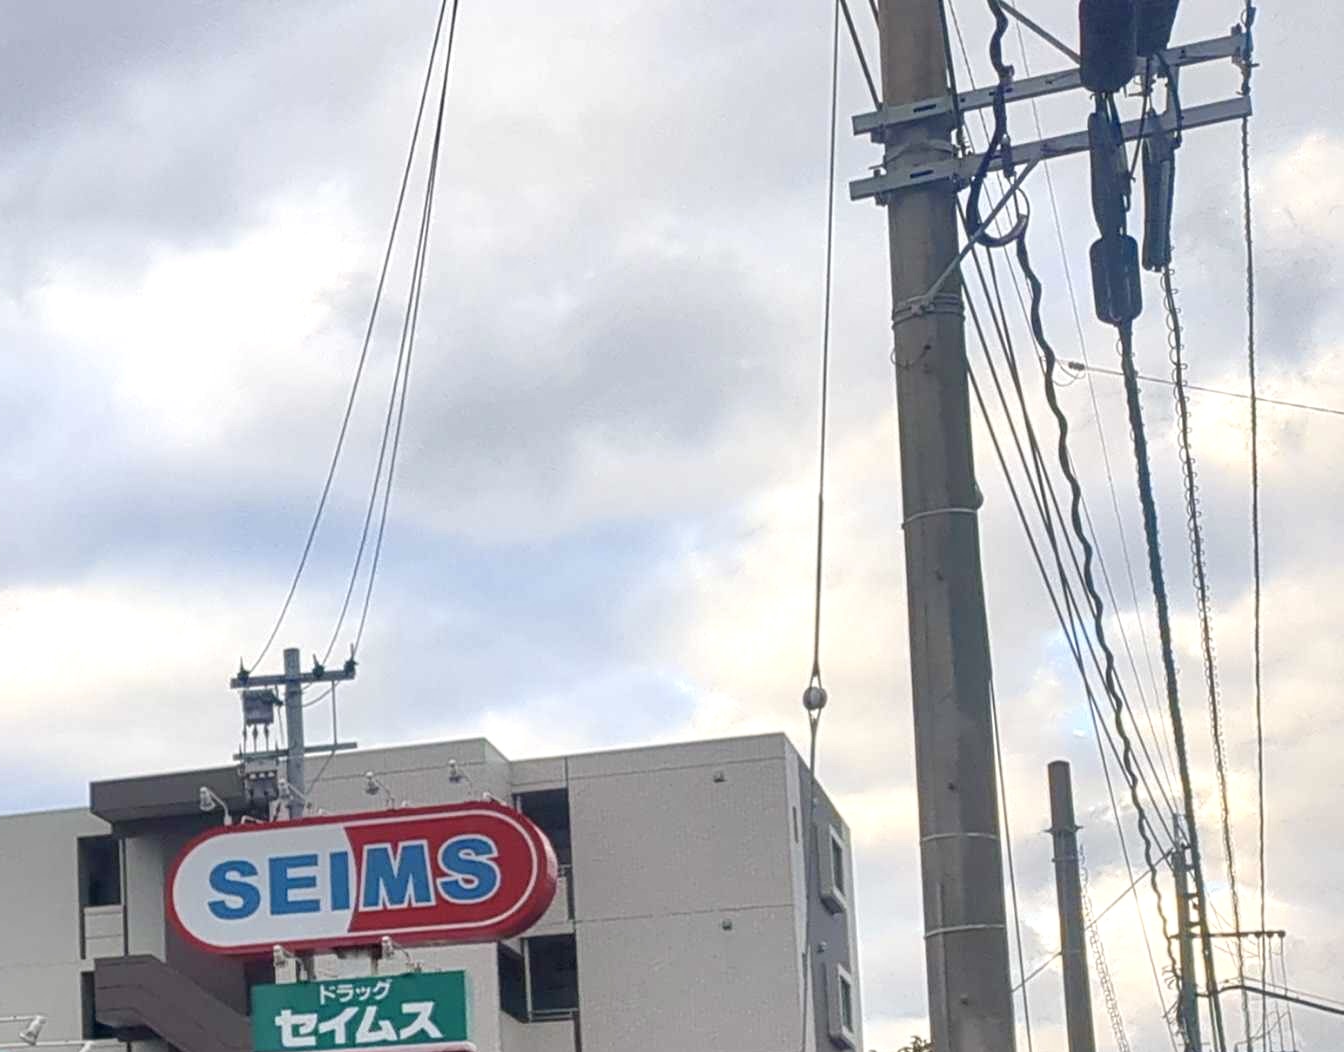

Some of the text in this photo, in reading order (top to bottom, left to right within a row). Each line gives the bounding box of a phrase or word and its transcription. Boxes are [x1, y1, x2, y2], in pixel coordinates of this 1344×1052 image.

[207, 836, 501, 921] SEIMS
[318, 979, 392, 1005] ドラッグ
[274, 1001, 443, 1048] セイムス
